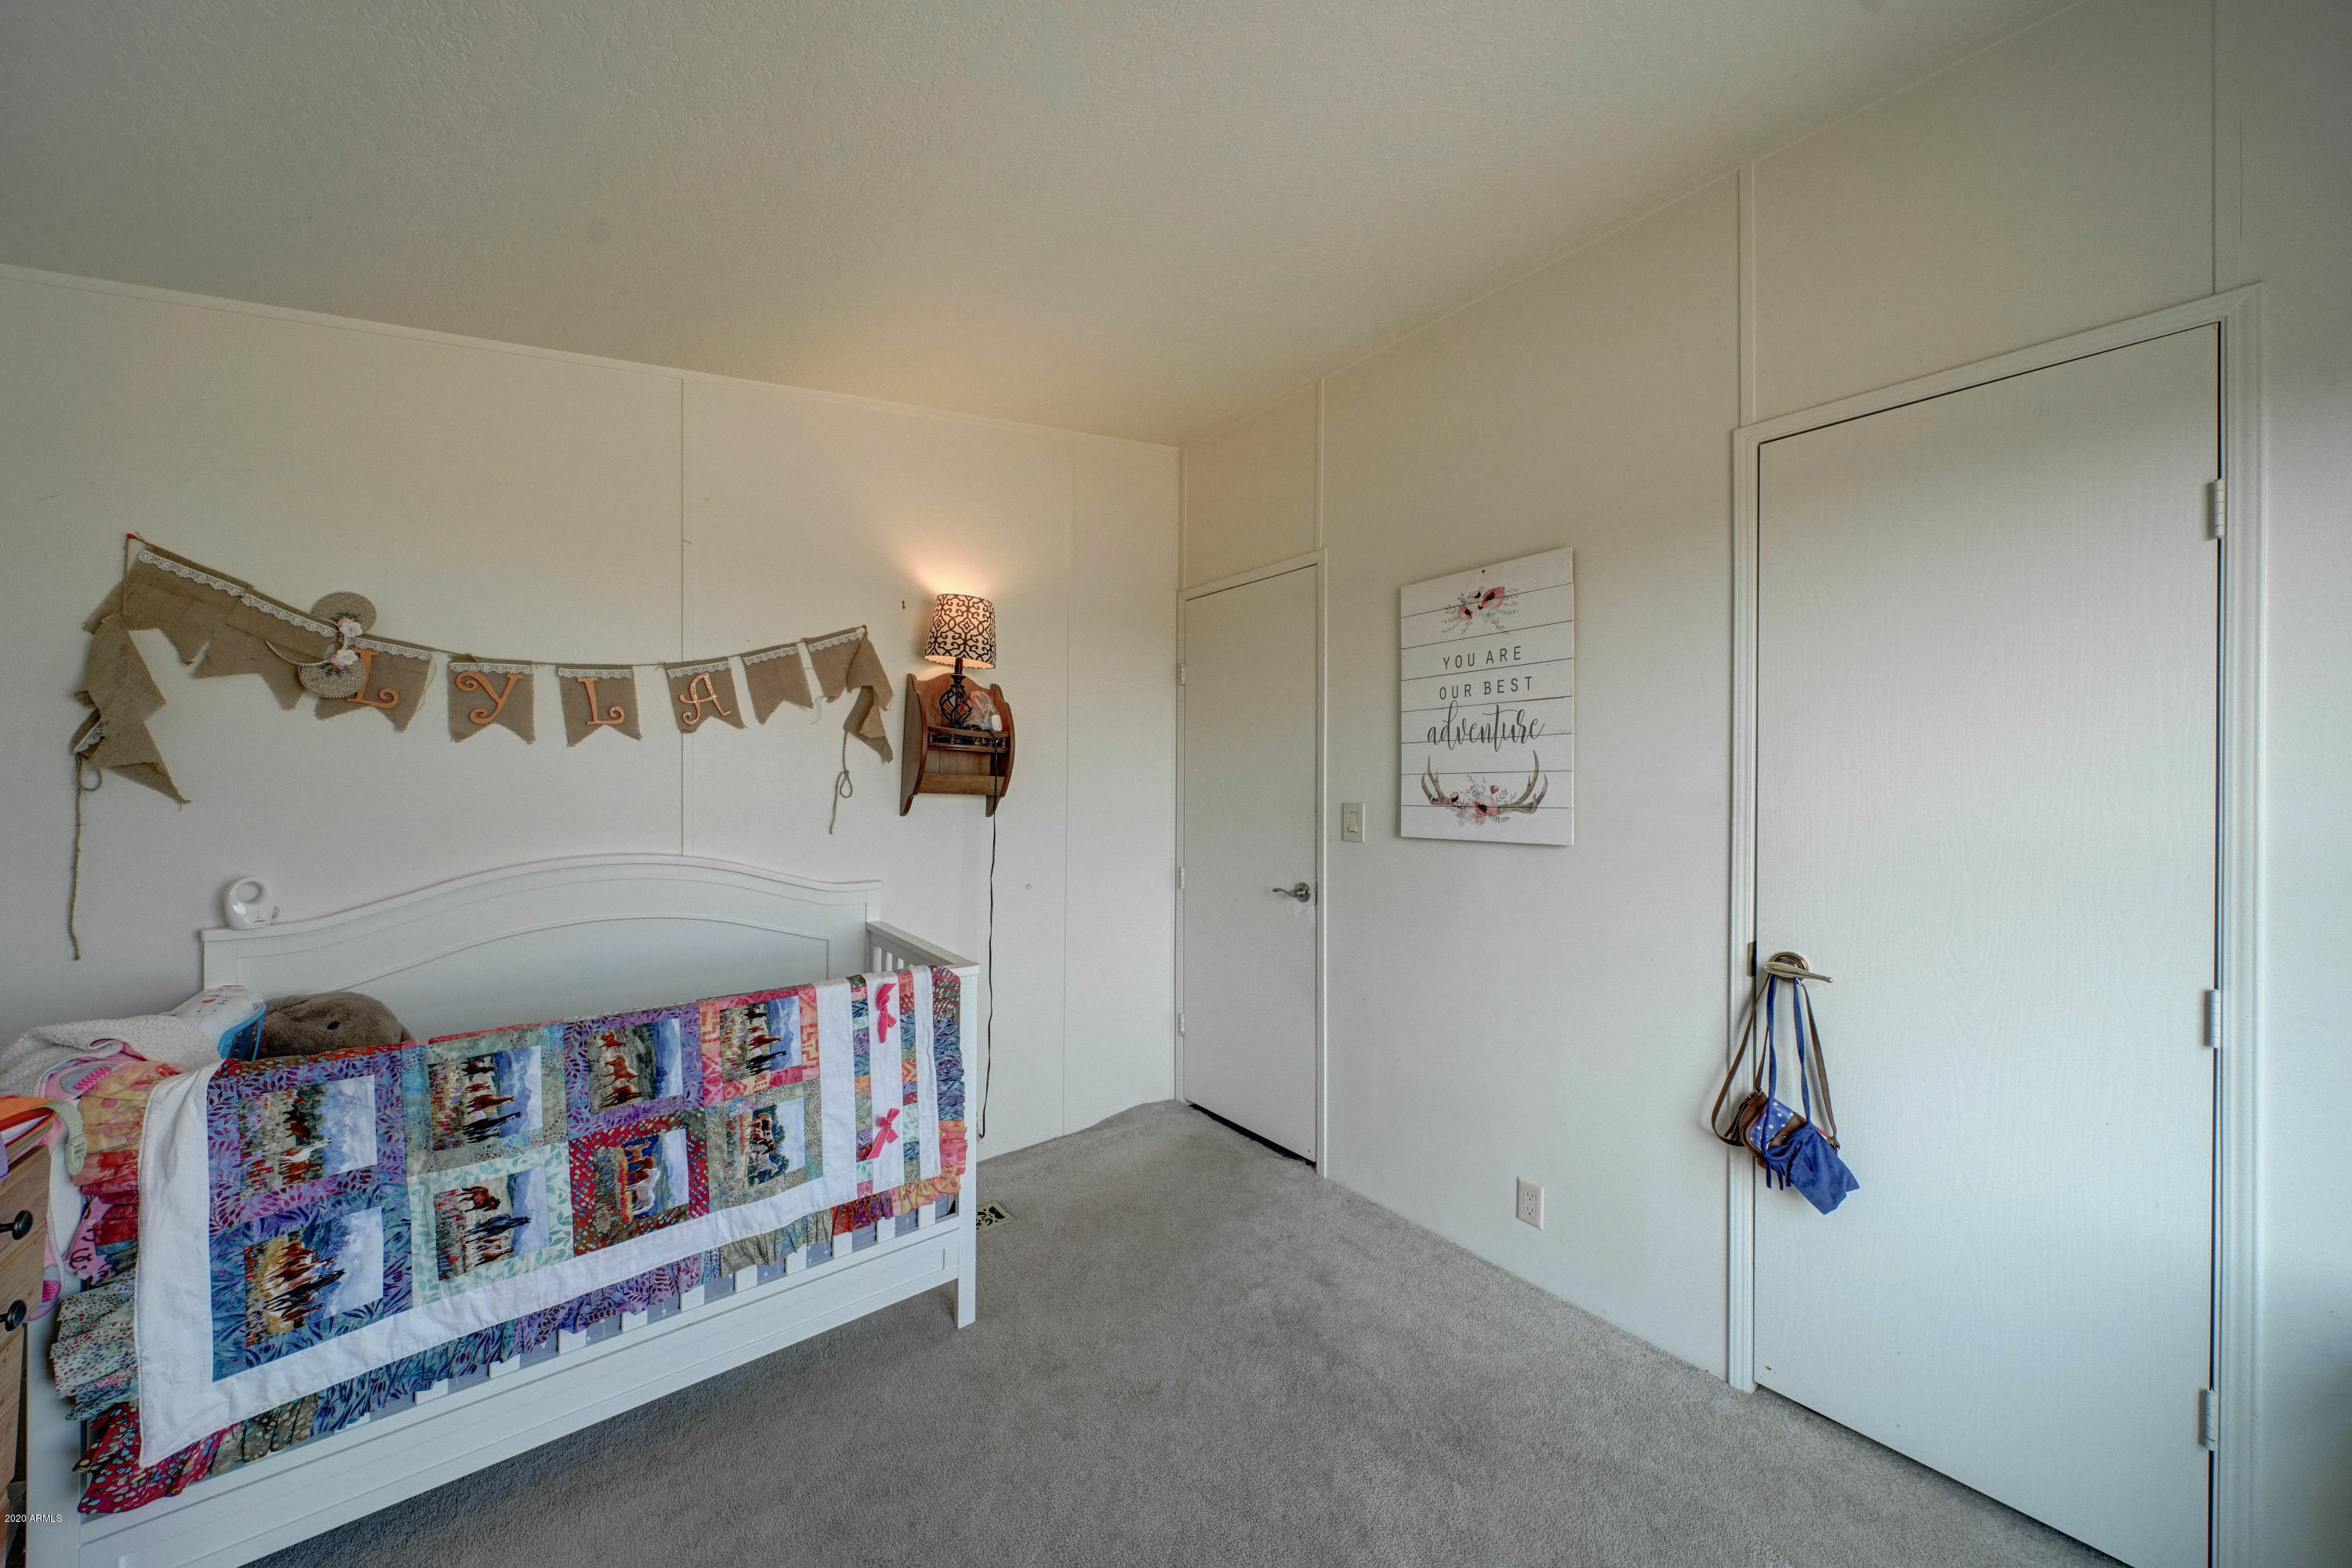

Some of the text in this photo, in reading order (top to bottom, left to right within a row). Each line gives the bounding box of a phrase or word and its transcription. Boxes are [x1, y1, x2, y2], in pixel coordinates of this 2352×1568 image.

[1443, 645, 1522, 670] YOU ARE
[1439, 676, 1533, 700] OUR BEST
[1427, 700, 1544, 752] adventure
